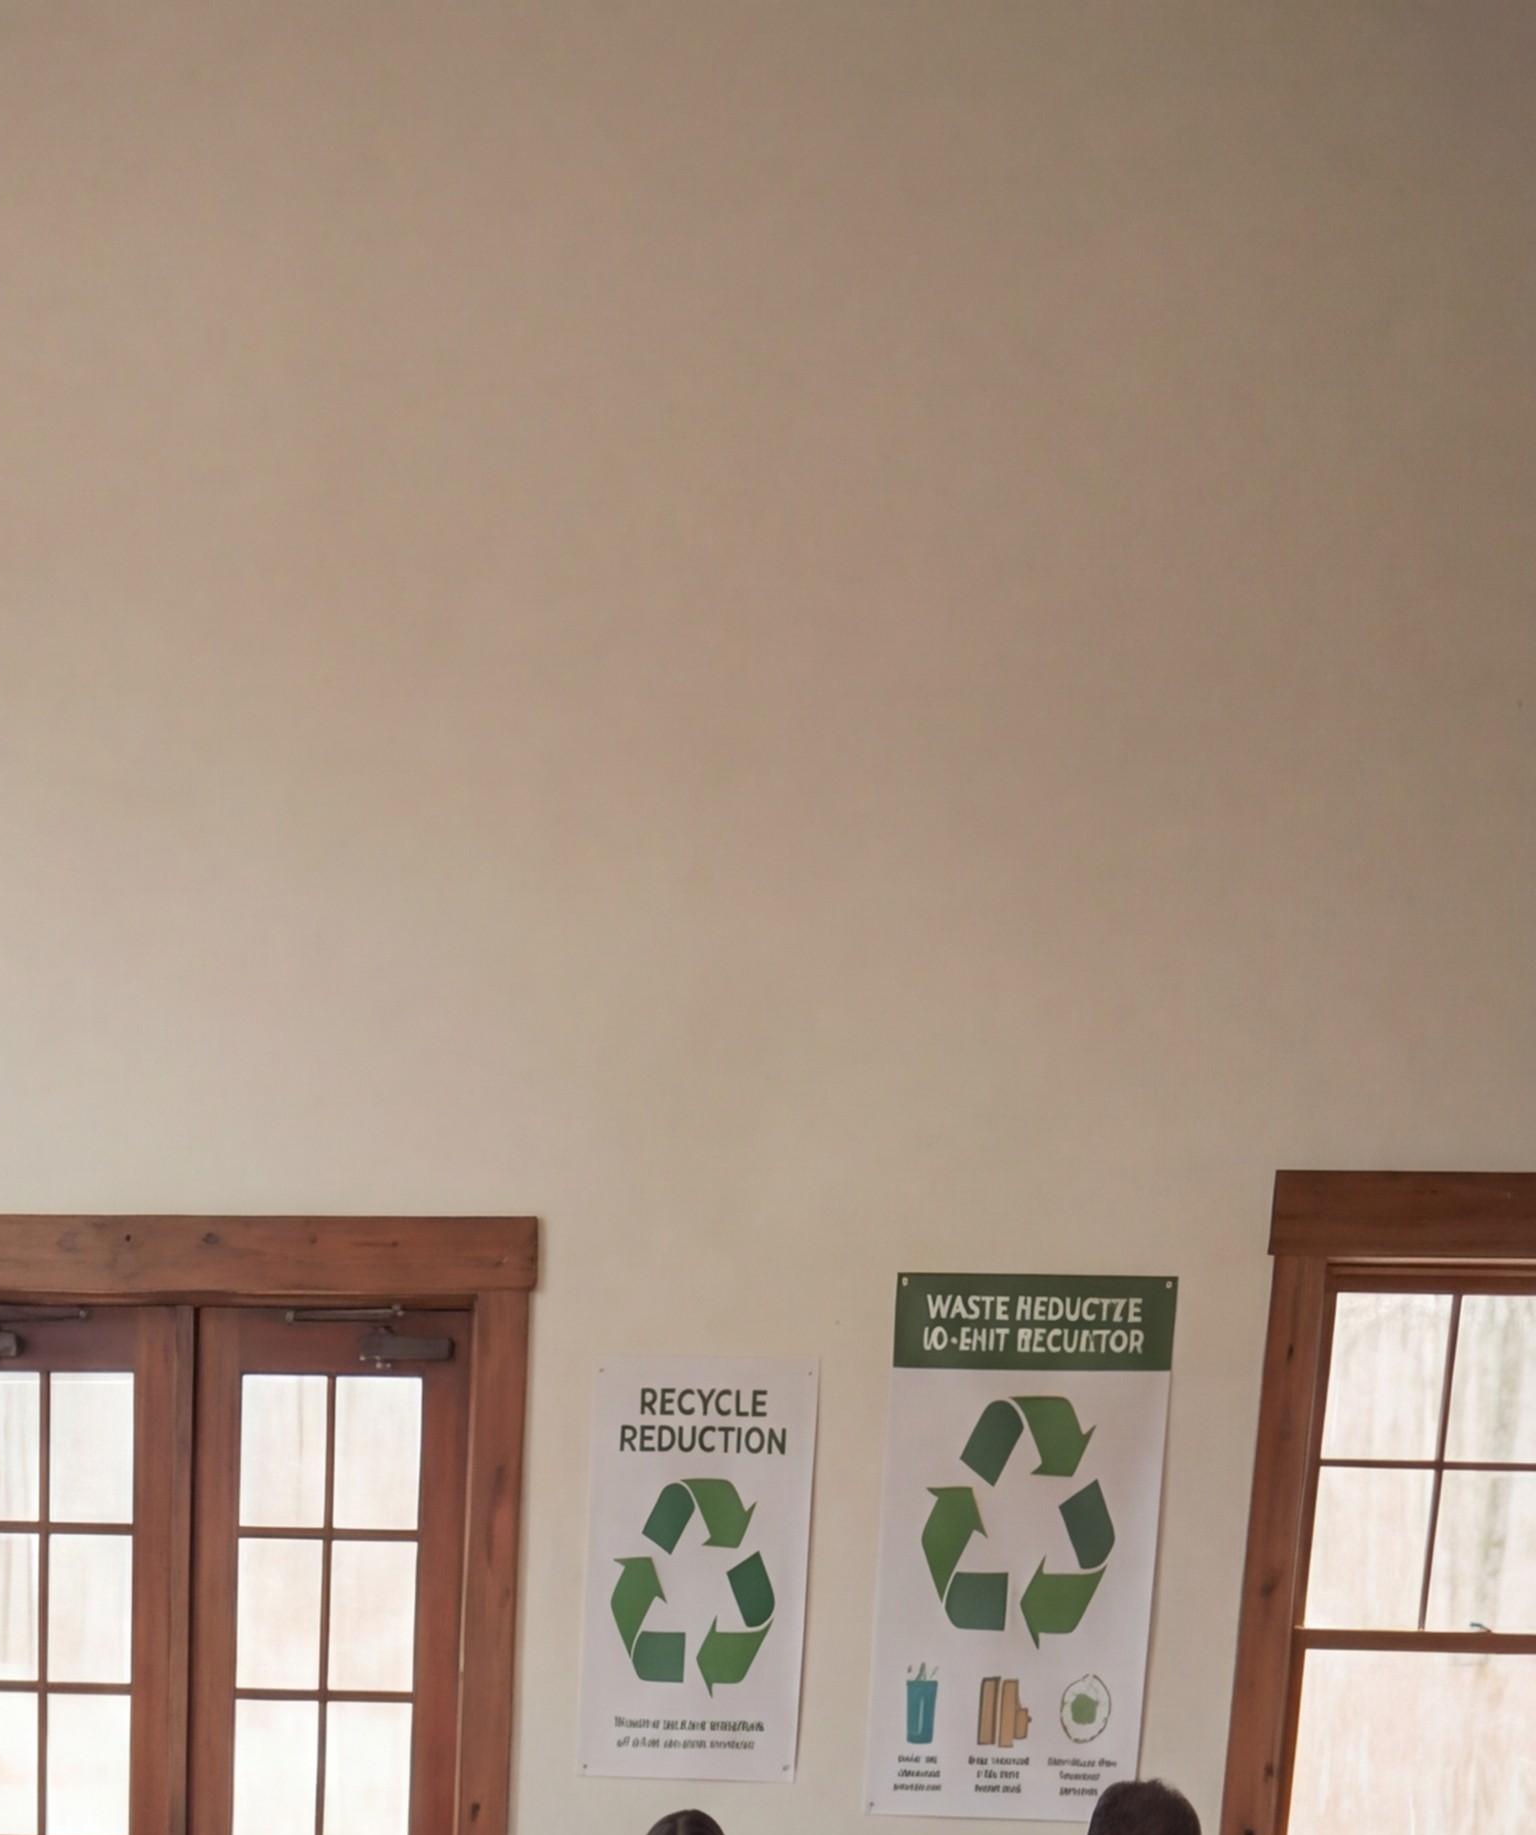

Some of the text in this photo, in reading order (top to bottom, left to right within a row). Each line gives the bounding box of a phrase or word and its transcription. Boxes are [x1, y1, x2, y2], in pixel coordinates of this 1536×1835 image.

[926, 1294, 1010, 1321] WASTE
[639, 1387, 768, 1417] RECYCLE
[619, 1424, 787, 1456] REDUCTION
